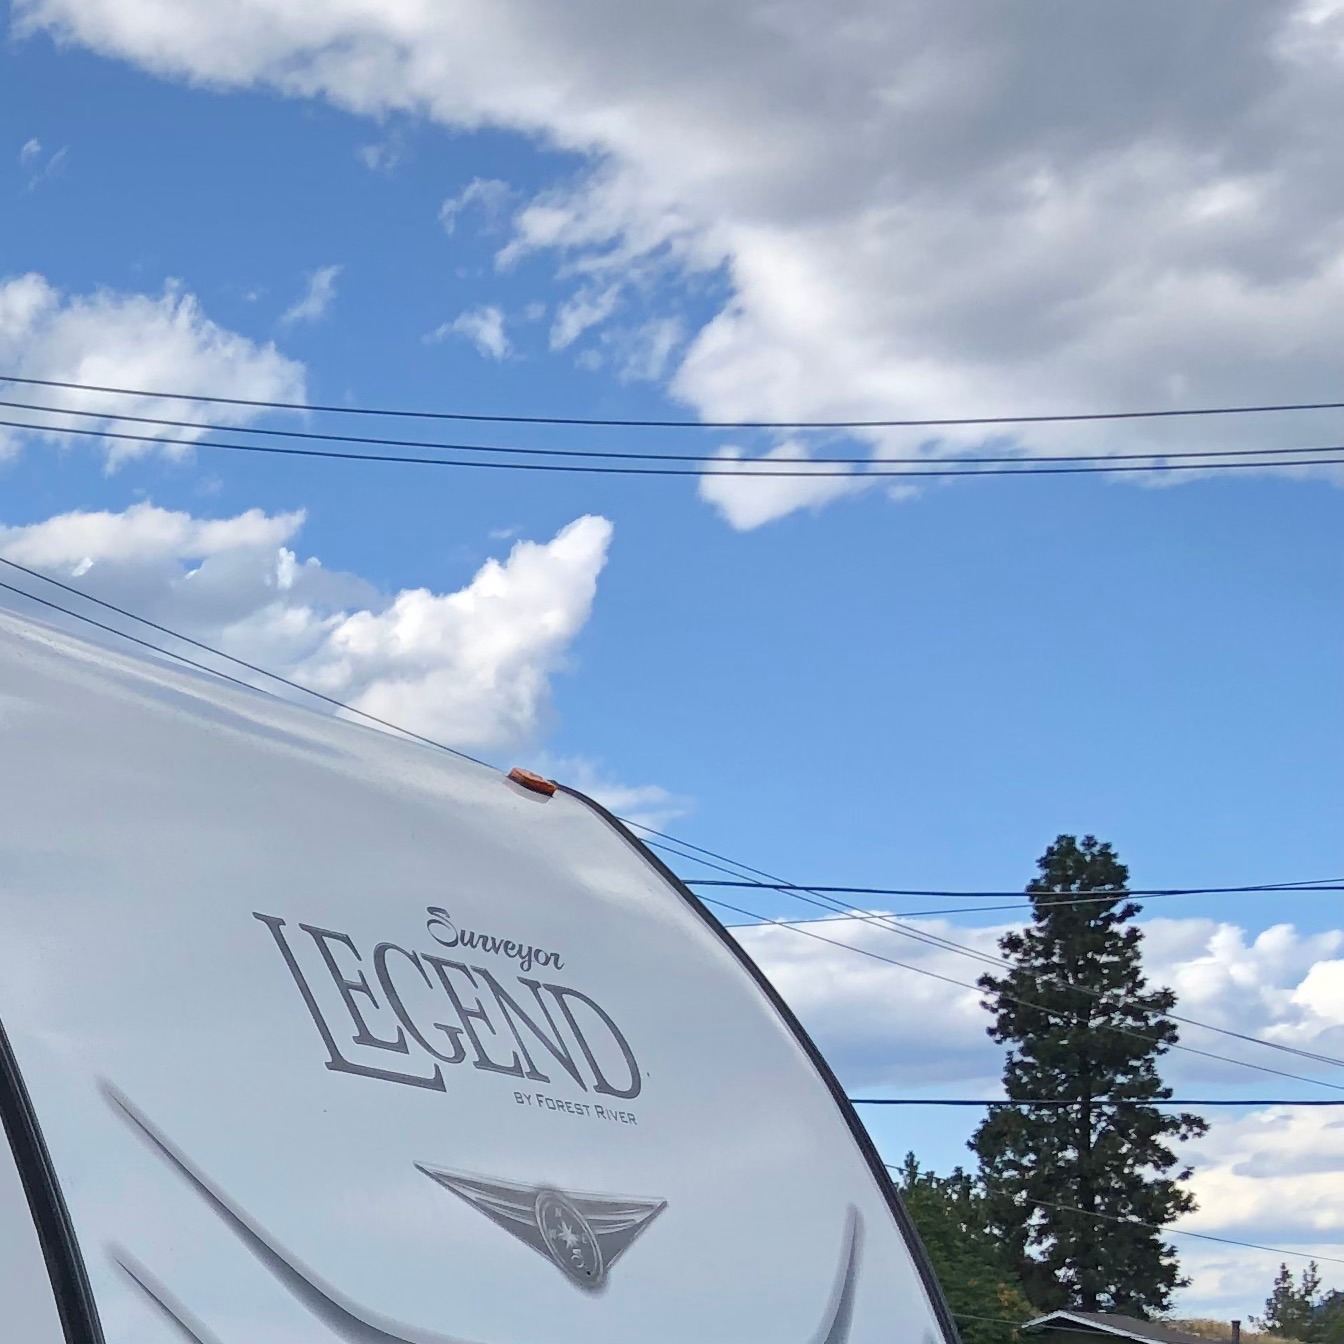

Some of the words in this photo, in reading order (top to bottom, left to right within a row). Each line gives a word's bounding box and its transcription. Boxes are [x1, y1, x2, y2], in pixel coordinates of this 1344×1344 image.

[426, 906, 564, 972] Surveyor
[252, 911, 642, 1100] LEGEND
[513, 1091, 532, 1106] BY
[536, 1093, 591, 1116] FOREST
[594, 1104, 638, 1126] RIVER
